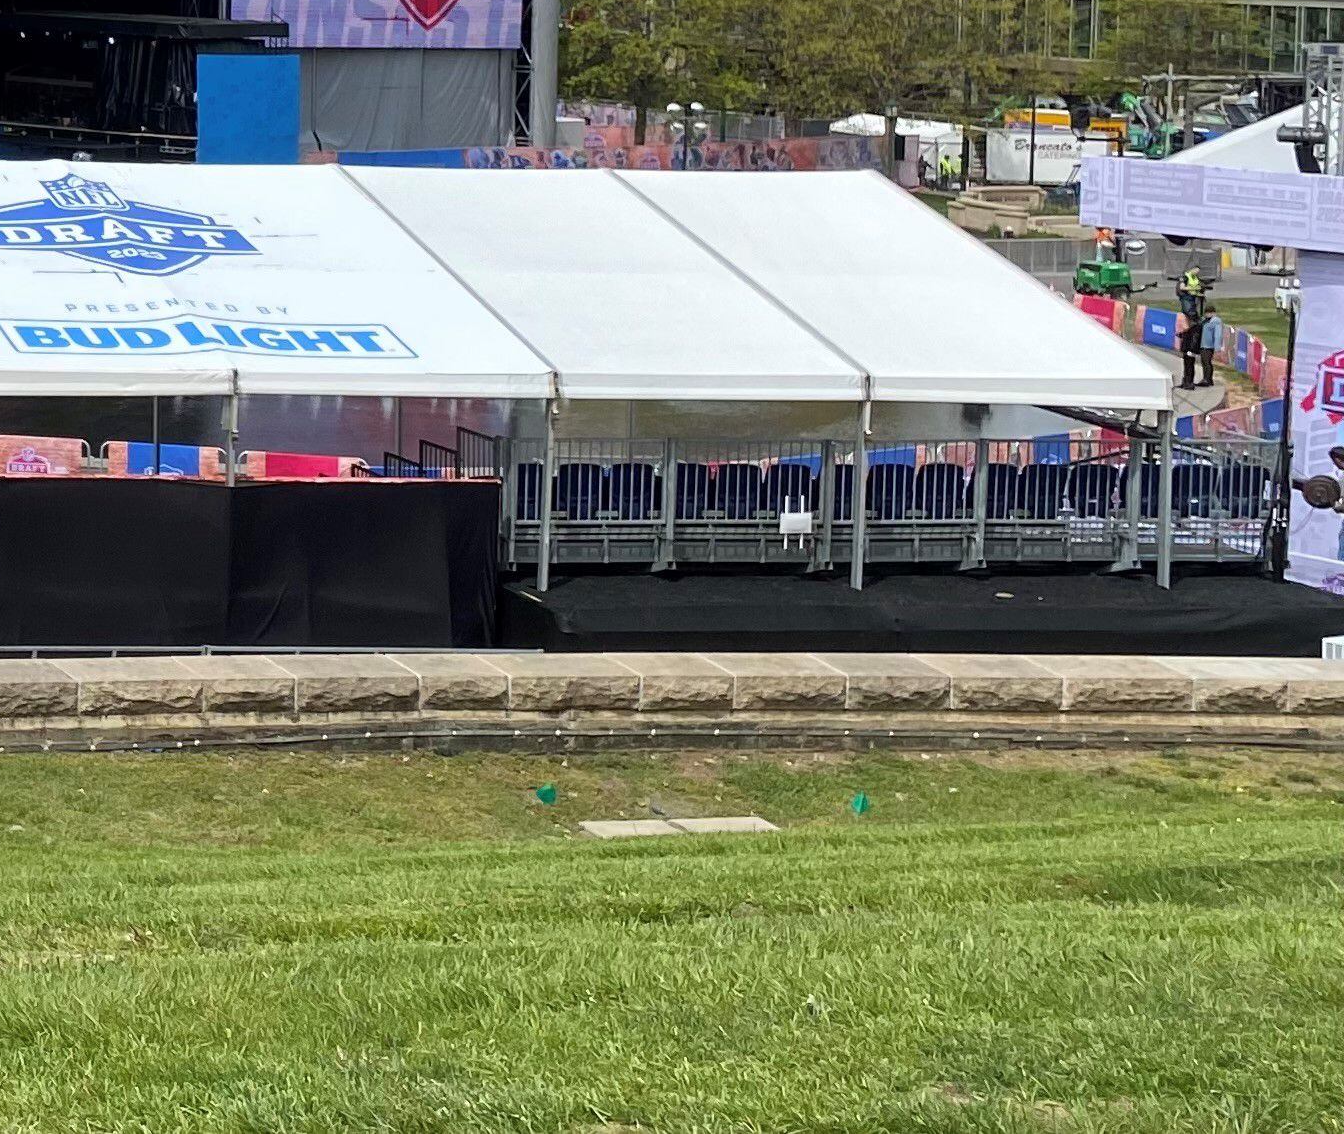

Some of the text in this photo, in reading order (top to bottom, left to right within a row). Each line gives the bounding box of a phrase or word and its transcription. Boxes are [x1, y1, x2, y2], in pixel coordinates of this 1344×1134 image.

[55, 188, 121, 207] NFL
[107, 247, 167, 261] 2023
[64, 297, 290, 315] PRESENTED BY
[13, 320, 388, 353] BUD LIGHT
